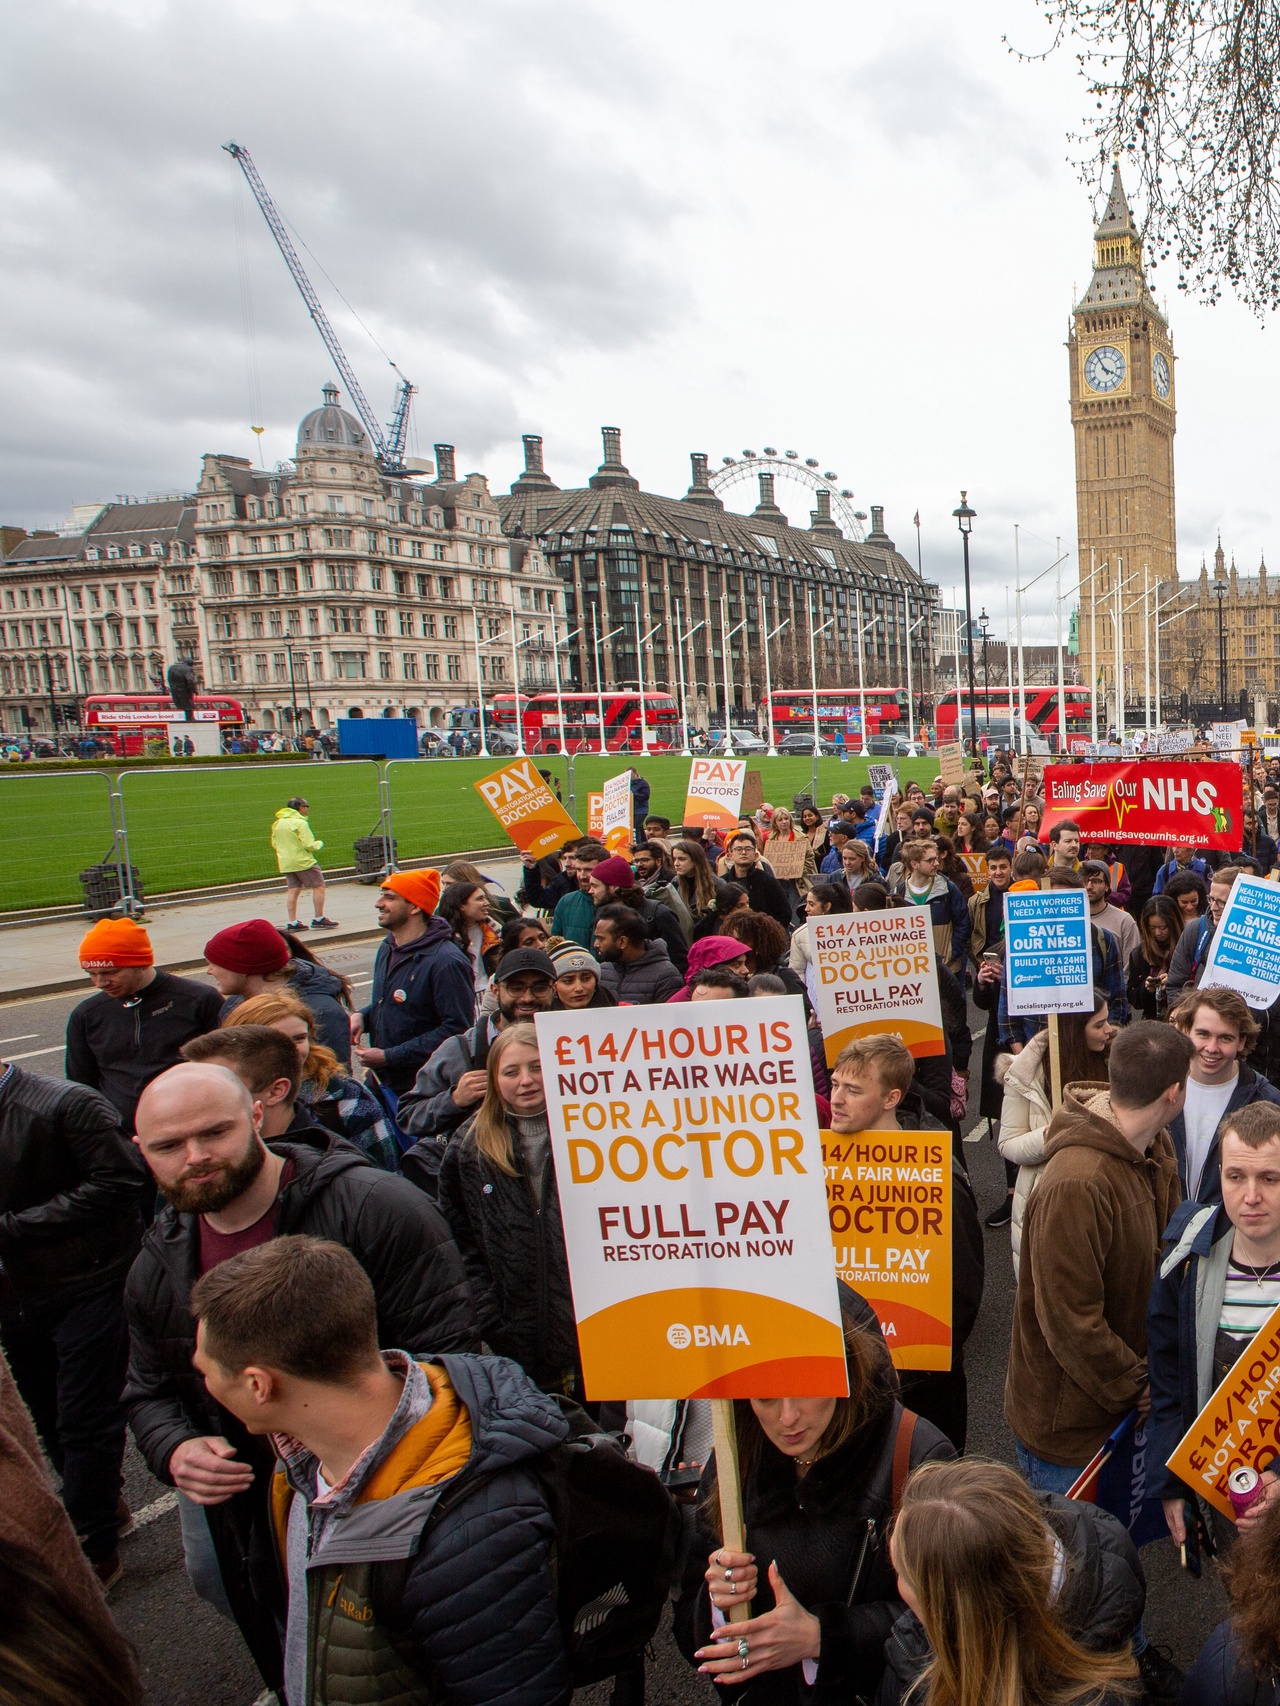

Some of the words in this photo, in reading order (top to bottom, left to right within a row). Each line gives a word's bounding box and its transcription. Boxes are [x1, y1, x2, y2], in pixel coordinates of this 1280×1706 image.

[1160, 738, 1188, 746] BARCLAY
[692, 761, 742, 782] PAY
[870, 768, 887, 776] STRIKE
[480, 761, 536, 810] PAY
[690, 786, 740, 796] DOCTORS
[496, 795, 533, 816] RESTORATION
[533, 785, 546, 796] FOR
[605, 794, 628, 812] DOCTOR
[1052, 780, 1082, 802] Ealing
[1084, 780, 1106, 802] Save
[1115, 778, 1137, 798] Our
[1142, 778, 1217, 816] NHS
[500, 792, 554, 826] DOCTORS
[606, 811, 618, 820] FULL
[618, 808, 626, 816] PAY
[545, 832, 559, 842] BMA
[1079, 829, 1209, 844] w.ealingsaveournhs.org.uk
[776, 853, 795, 863] KEEPS
[1010, 898, 1040, 908] HEALTH
[1041, 896, 1082, 906] WORKERS
[1238, 886, 1266, 900] HEALTH
[1013, 907, 1034, 916] NEED
[1036, 907, 1041, 915] A
[1042, 906, 1059, 915] PAY
[1060, 905, 1080, 914] RISE
[1238, 895, 1260, 907] NEED
[1264, 900, 1278, 912] PAY
[815, 917, 906, 938] £14/HOUR
[911, 915, 926, 929] IS
[1028, 924, 1065, 937] SAVE
[1228, 922, 1257, 938] OUR
[1244, 915, 1278, 934] SAVE
[817, 938, 844, 950] NOT
[847, 938, 856, 948] A
[859, 934, 887, 946] FAIR
[890, 930, 927, 942] WAGE
[1013, 938, 1044, 950] OUR
[1046, 936, 1082, 948] NHS!
[1223, 939, 1246, 952] BUILD
[1246, 946, 1260, 956] FOR
[818, 950, 851, 964] FOR
[855, 949, 867, 961] A
[870, 942, 928, 962] JUNIOR
[1014, 957, 1038, 967] BUILD
[1039, 957, 1055, 966] FOR
[1057, 956, 1063, 965] A
[1063, 955, 1085, 965] 24HR
[820, 956, 930, 985] DOCTOR
[1045, 965, 1086, 975] GENERAL
[1055, 974, 1086, 984] STRIKE
[1250, 967, 1280, 984] STRIKE
[834, 988, 884, 1006] FULL
[888, 982, 922, 999] PAY
[836, 1001, 900, 1014] RESTORATION
[902, 997, 924, 1006] NOW
[1016, 1001, 1084, 1010] socialistparty.org.uk
[554, 1026, 750, 1066] £14/HOUR
[759, 1021, 793, 1054] IS
[558, 1070, 615, 1096] NOT
[623, 1069, 642, 1093] A
[648, 1065, 709, 1091] FAIR
[715, 1060, 797, 1086] WAGE
[562, 1100, 632, 1132] FOR
[641, 1099, 666, 1128] A
[672, 1091, 802, 1132] JUNIOR
[566, 1128, 808, 1184] DOCTOR
[821, 1142, 918, 1164] 14/HOUR
[924, 1145, 943, 1164] IS
[841, 1167, 853, 1181] A
[857, 1167, 893, 1182] FAIR
[896, 1168, 943, 1183] WAGE
[850, 1185, 864, 1202] A
[868, 1186, 943, 1205] JUNIOR
[598, 1202, 707, 1241] FULL
[714, 1199, 790, 1236] PAY
[830, 1205, 943, 1236] OCTOR
[603, 1242, 742, 1262] RESTORATION
[745, 1239, 794, 1258] NOW
[834, 1246, 880, 1269] ULL
[886, 1248, 930, 1270] PAY
[901, 1271, 930, 1284] NOW
[694, 1324, 751, 1347] BMA
[1201, 1433, 1236, 1486] NOT
[1237, 1417, 1252, 1437] A
[1214, 1437, 1258, 1499] FOR
[1257, 1417, 1274, 1439] A
[348, 1602, 373, 1620] Rab
